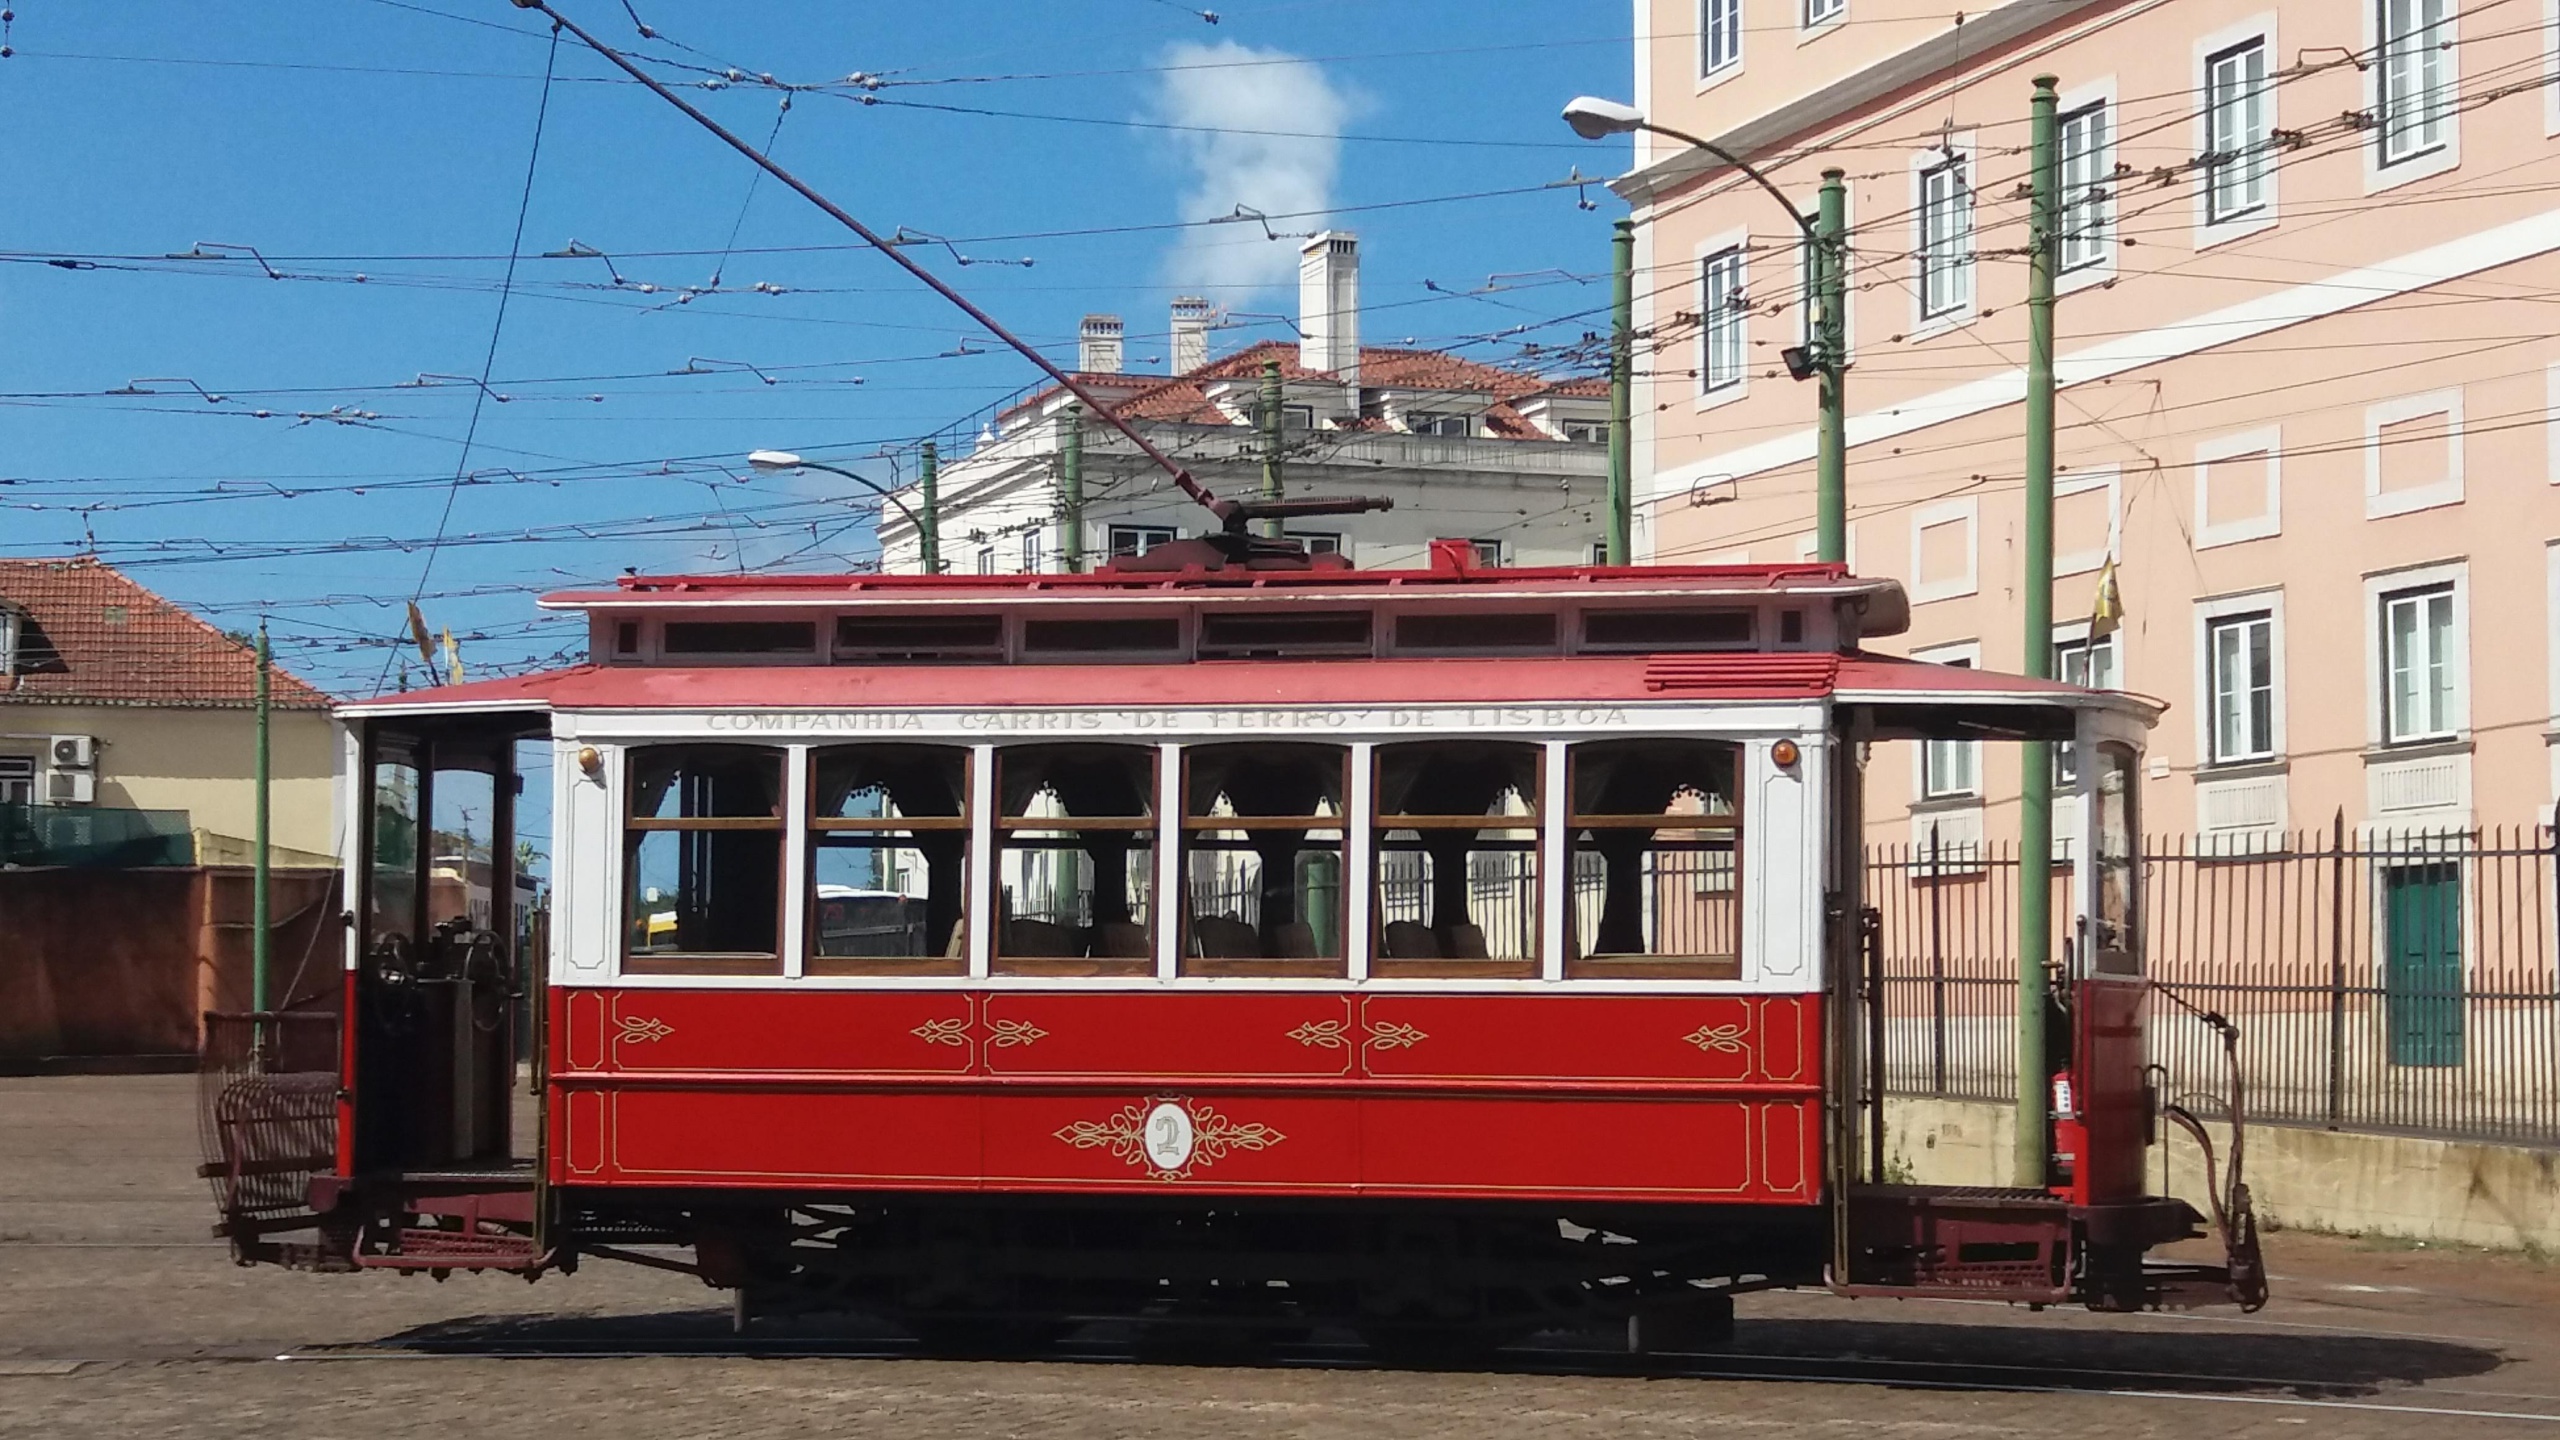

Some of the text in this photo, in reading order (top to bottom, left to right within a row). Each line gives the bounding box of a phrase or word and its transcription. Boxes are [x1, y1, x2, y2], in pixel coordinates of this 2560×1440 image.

[705, 709, 1629, 730] COMPANHIA CARRIS DE FERRO DE LISBOA
[1154, 1116, 1181, 1156] 2
